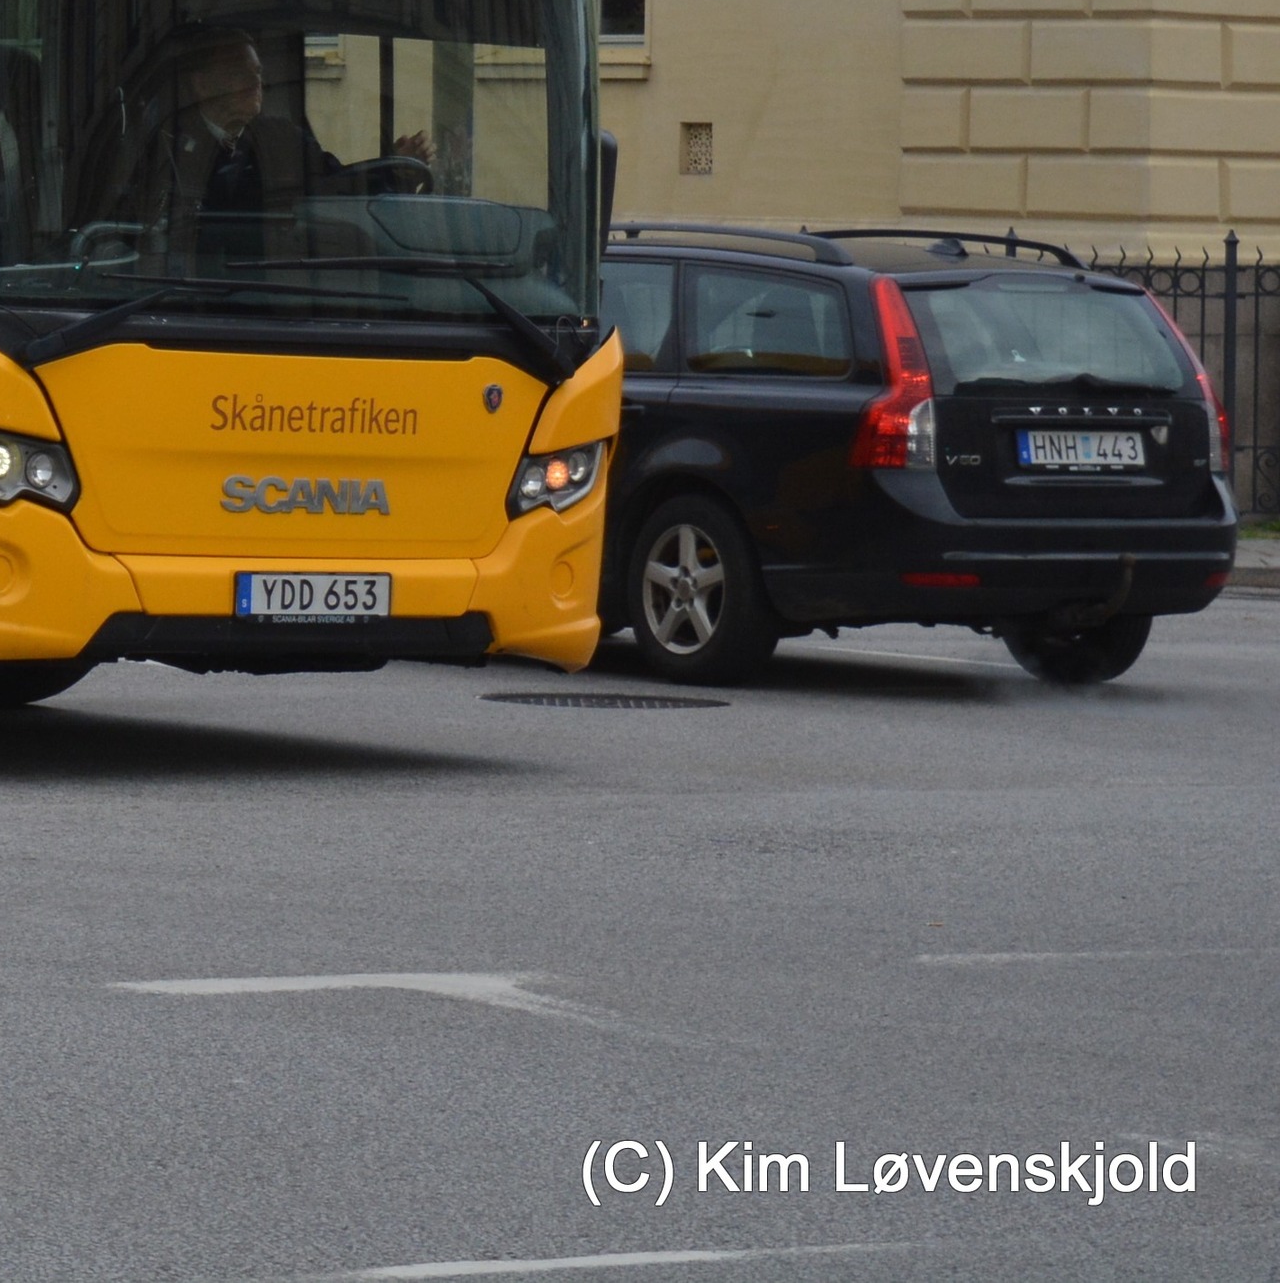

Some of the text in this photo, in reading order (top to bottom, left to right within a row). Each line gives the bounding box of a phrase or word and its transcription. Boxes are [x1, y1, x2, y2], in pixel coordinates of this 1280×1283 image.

[210, 393, 418, 435] Skånetrafiken
[1033, 435, 1138, 461] HNH 443
[220, 475, 390, 515] SCANIA
[262, 579, 313, 610] YDD
[324, 579, 377, 610] 653
